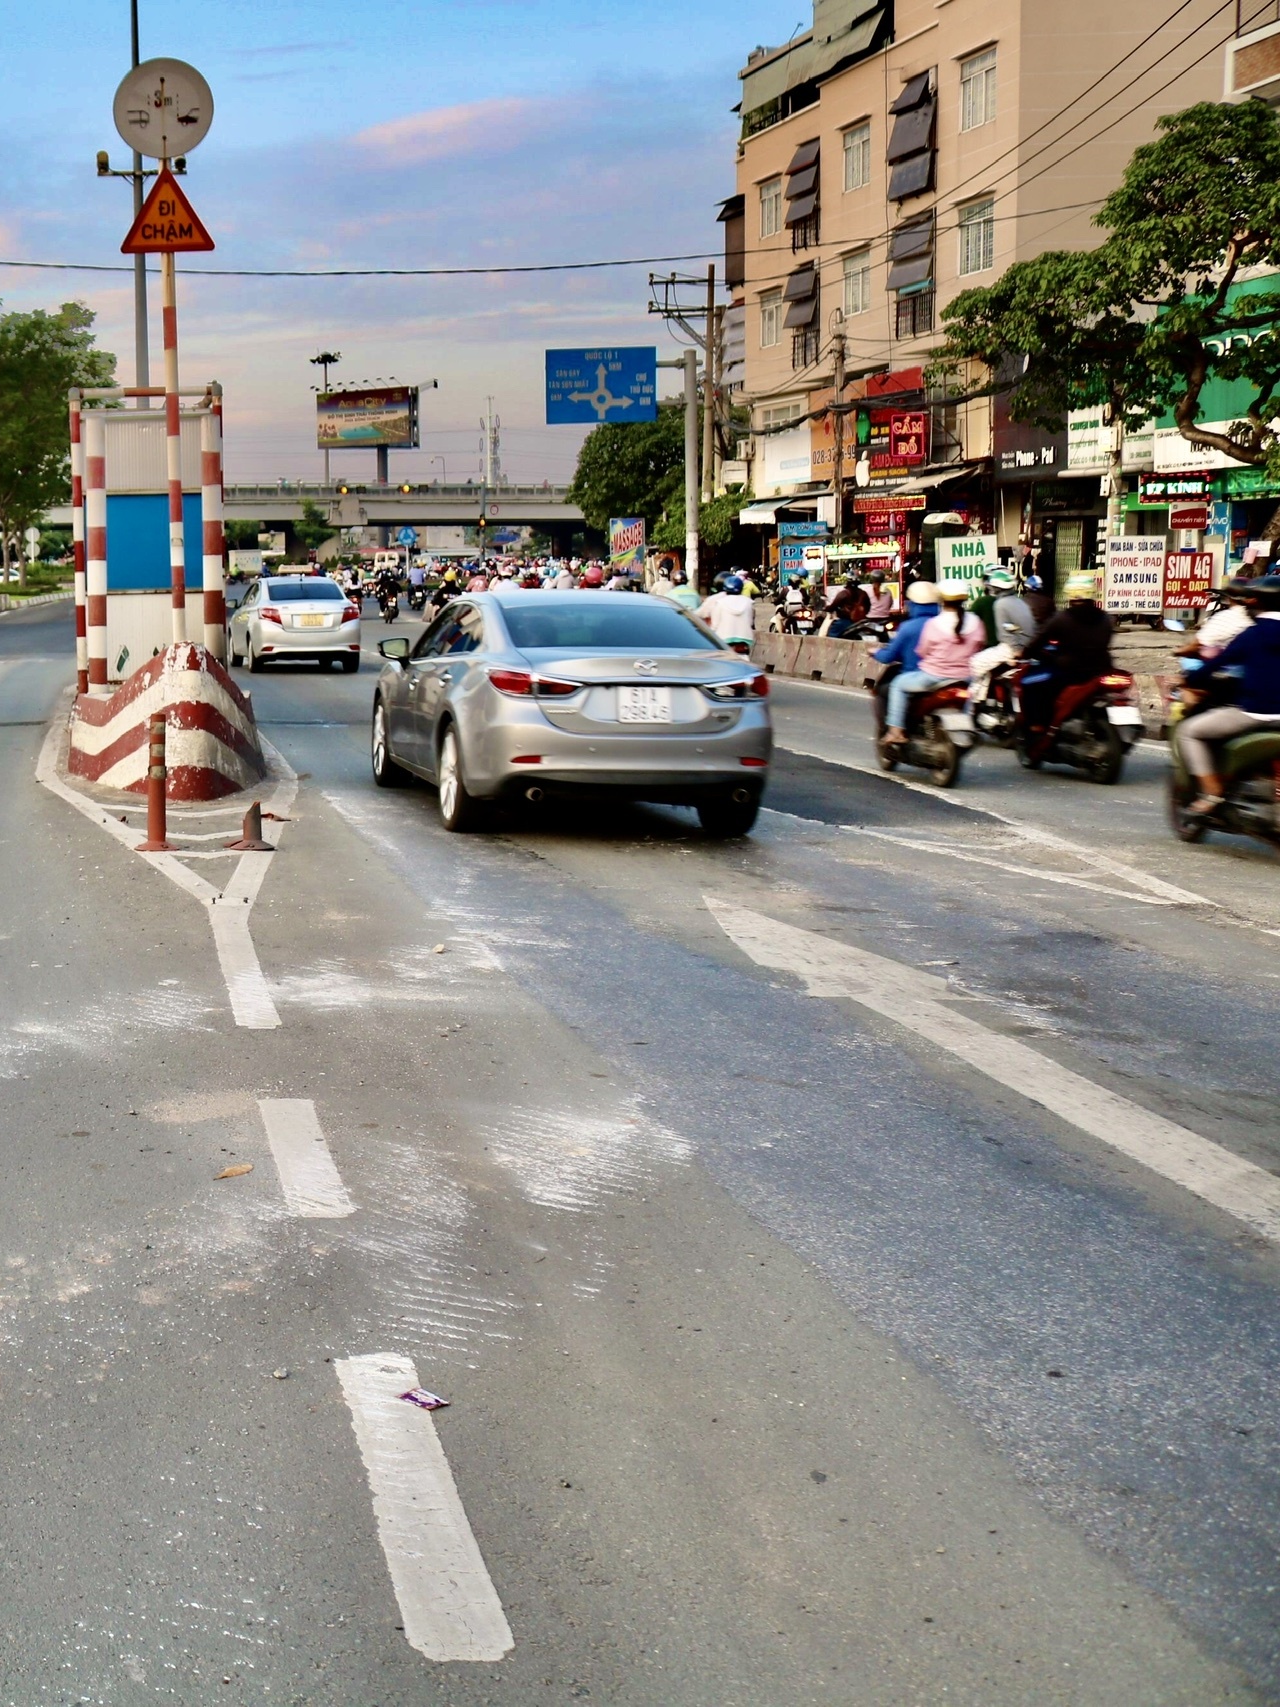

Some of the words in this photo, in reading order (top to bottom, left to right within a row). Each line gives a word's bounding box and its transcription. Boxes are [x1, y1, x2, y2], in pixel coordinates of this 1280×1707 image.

[159, 200, 175, 216] ĐI
[141, 219, 193, 242] CHẬM
[951, 539, 986, 558] NHÀ
[1110, 542, 1121, 551] MUA
[1123, 540, 1133, 551] BÁN
[1110, 557, 1138, 567] IPHONE
[1143, 557, 1162, 566] IPAD
[1167, 555, 1191, 579] SIM
[1194, 555, 1210, 579] 4G
[943, 558, 988, 580] THUỐ
[1113, 573, 1158, 583] SAMSUNG
[1108, 589, 1116, 597] ÉP
[1166, 581, 1180, 594] GỌI
[1121, 599, 1129, 608] SỐ
